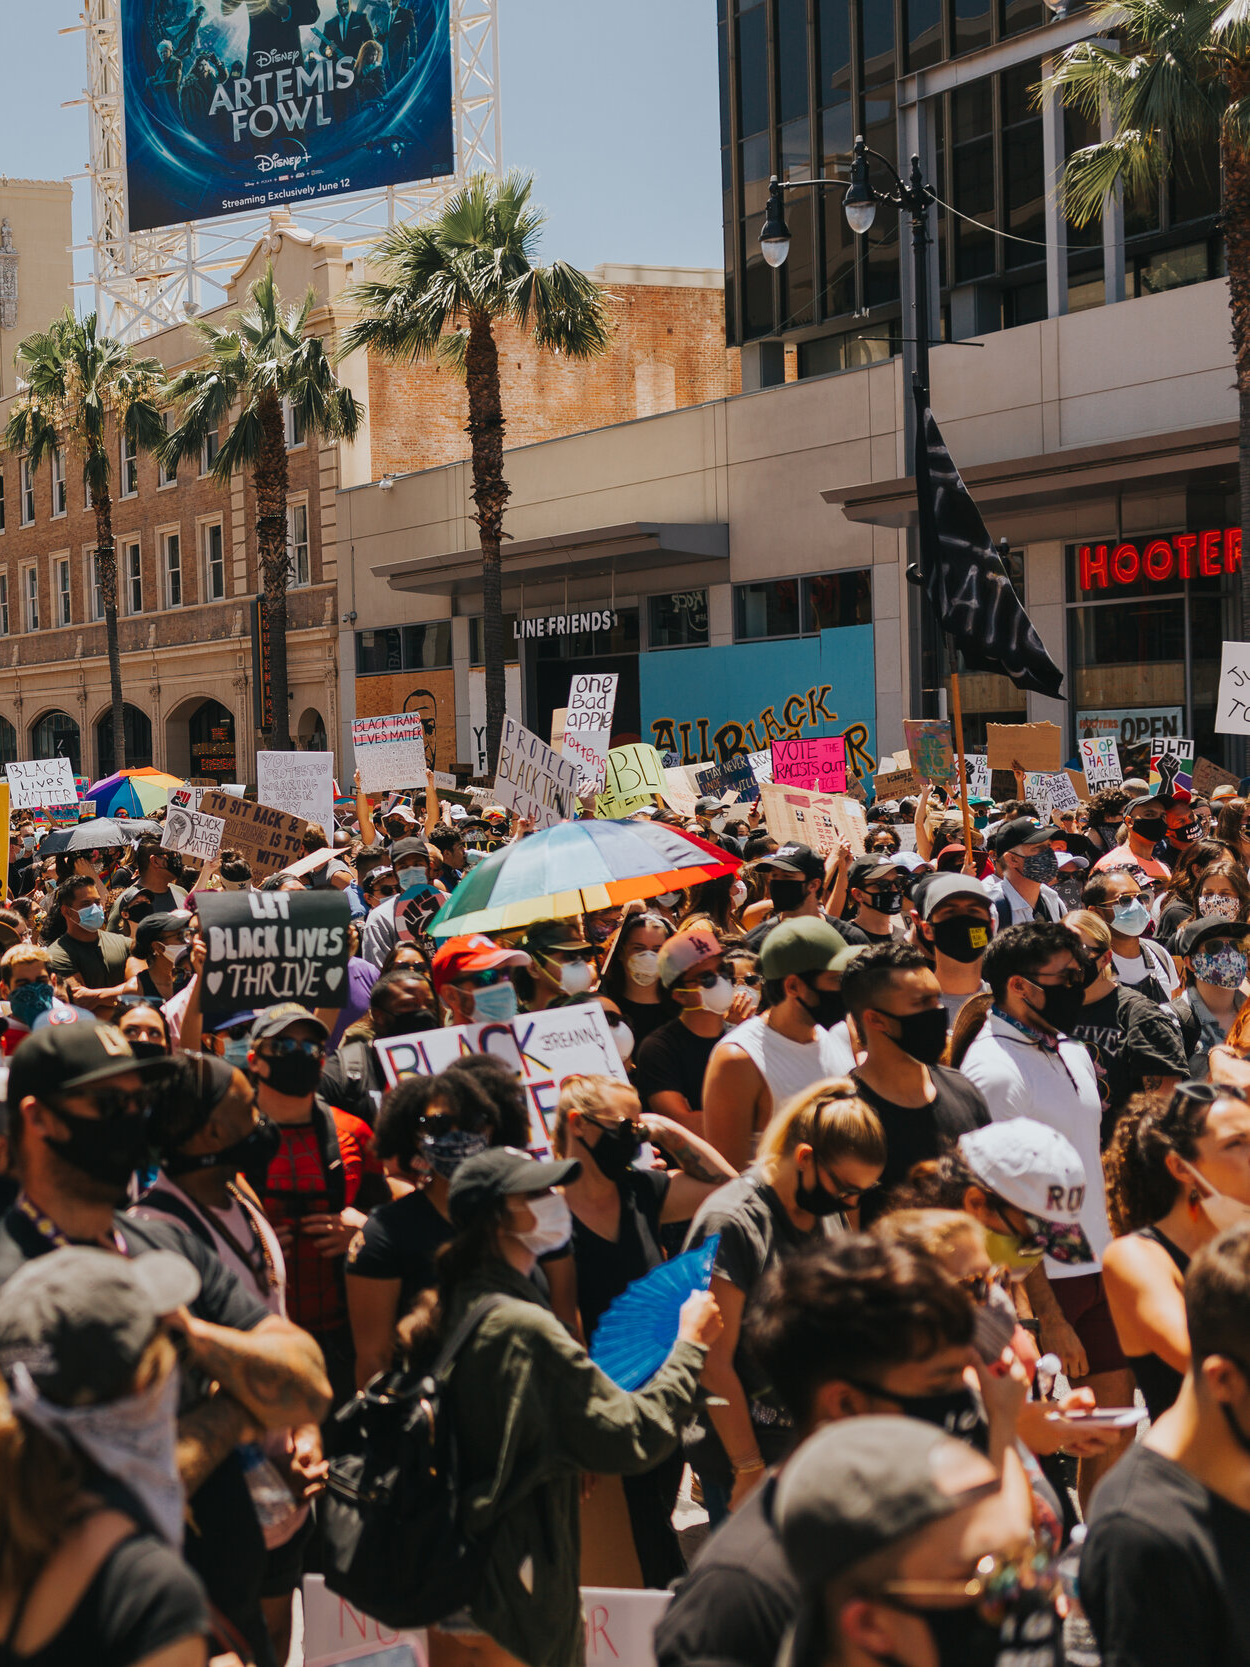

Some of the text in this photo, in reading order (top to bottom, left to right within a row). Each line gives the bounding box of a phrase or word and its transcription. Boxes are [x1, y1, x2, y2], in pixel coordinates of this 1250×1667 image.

[208, 56, 356, 116] ARTEMIS
[232, 95, 332, 143] FOWL
[222, 178, 350, 209] Streaming Exclusively June 12
[514, 610, 611, 640] LINE FRIENDS
[576, 676, 613, 694] one
[572, 693, 607, 710] Bad
[354, 718, 388, 732] BLACK
[567, 711, 613, 731] apple
[710, 684, 839, 762] BLACK
[1079, 714, 1178, 745] HOOTERS OPEN
[354, 726, 423, 746] LIVES MATTER
[505, 719, 577, 787] PROTECT
[773, 740, 840, 761] VOTE THE
[1083, 738, 1114, 756] STOP
[1153, 739, 1191, 758] BLM
[9, 760, 69, 779] BLACK
[262, 754, 295, 768] YOU
[704, 755, 748, 781] MAY NEVER
[776, 760, 846, 779] RACISTS OUT
[1089, 753, 1116, 767] HATE
[498, 745, 542, 800] BLACK
[20, 776, 63, 791] Lives
[18, 788, 72, 806] MATTER
[191, 813, 221, 833] BLACK
[211, 793, 299, 833] TO SIT BACK &
[194, 828, 219, 844] LIVES
[269, 831, 282, 847] IS
[186, 838, 219, 858] MATTER
[256, 848, 290, 869] WITH
[248, 892, 291, 920] LET
[208, 925, 344, 962] BLACK LIVES
[228, 957, 323, 998] THRIVE
